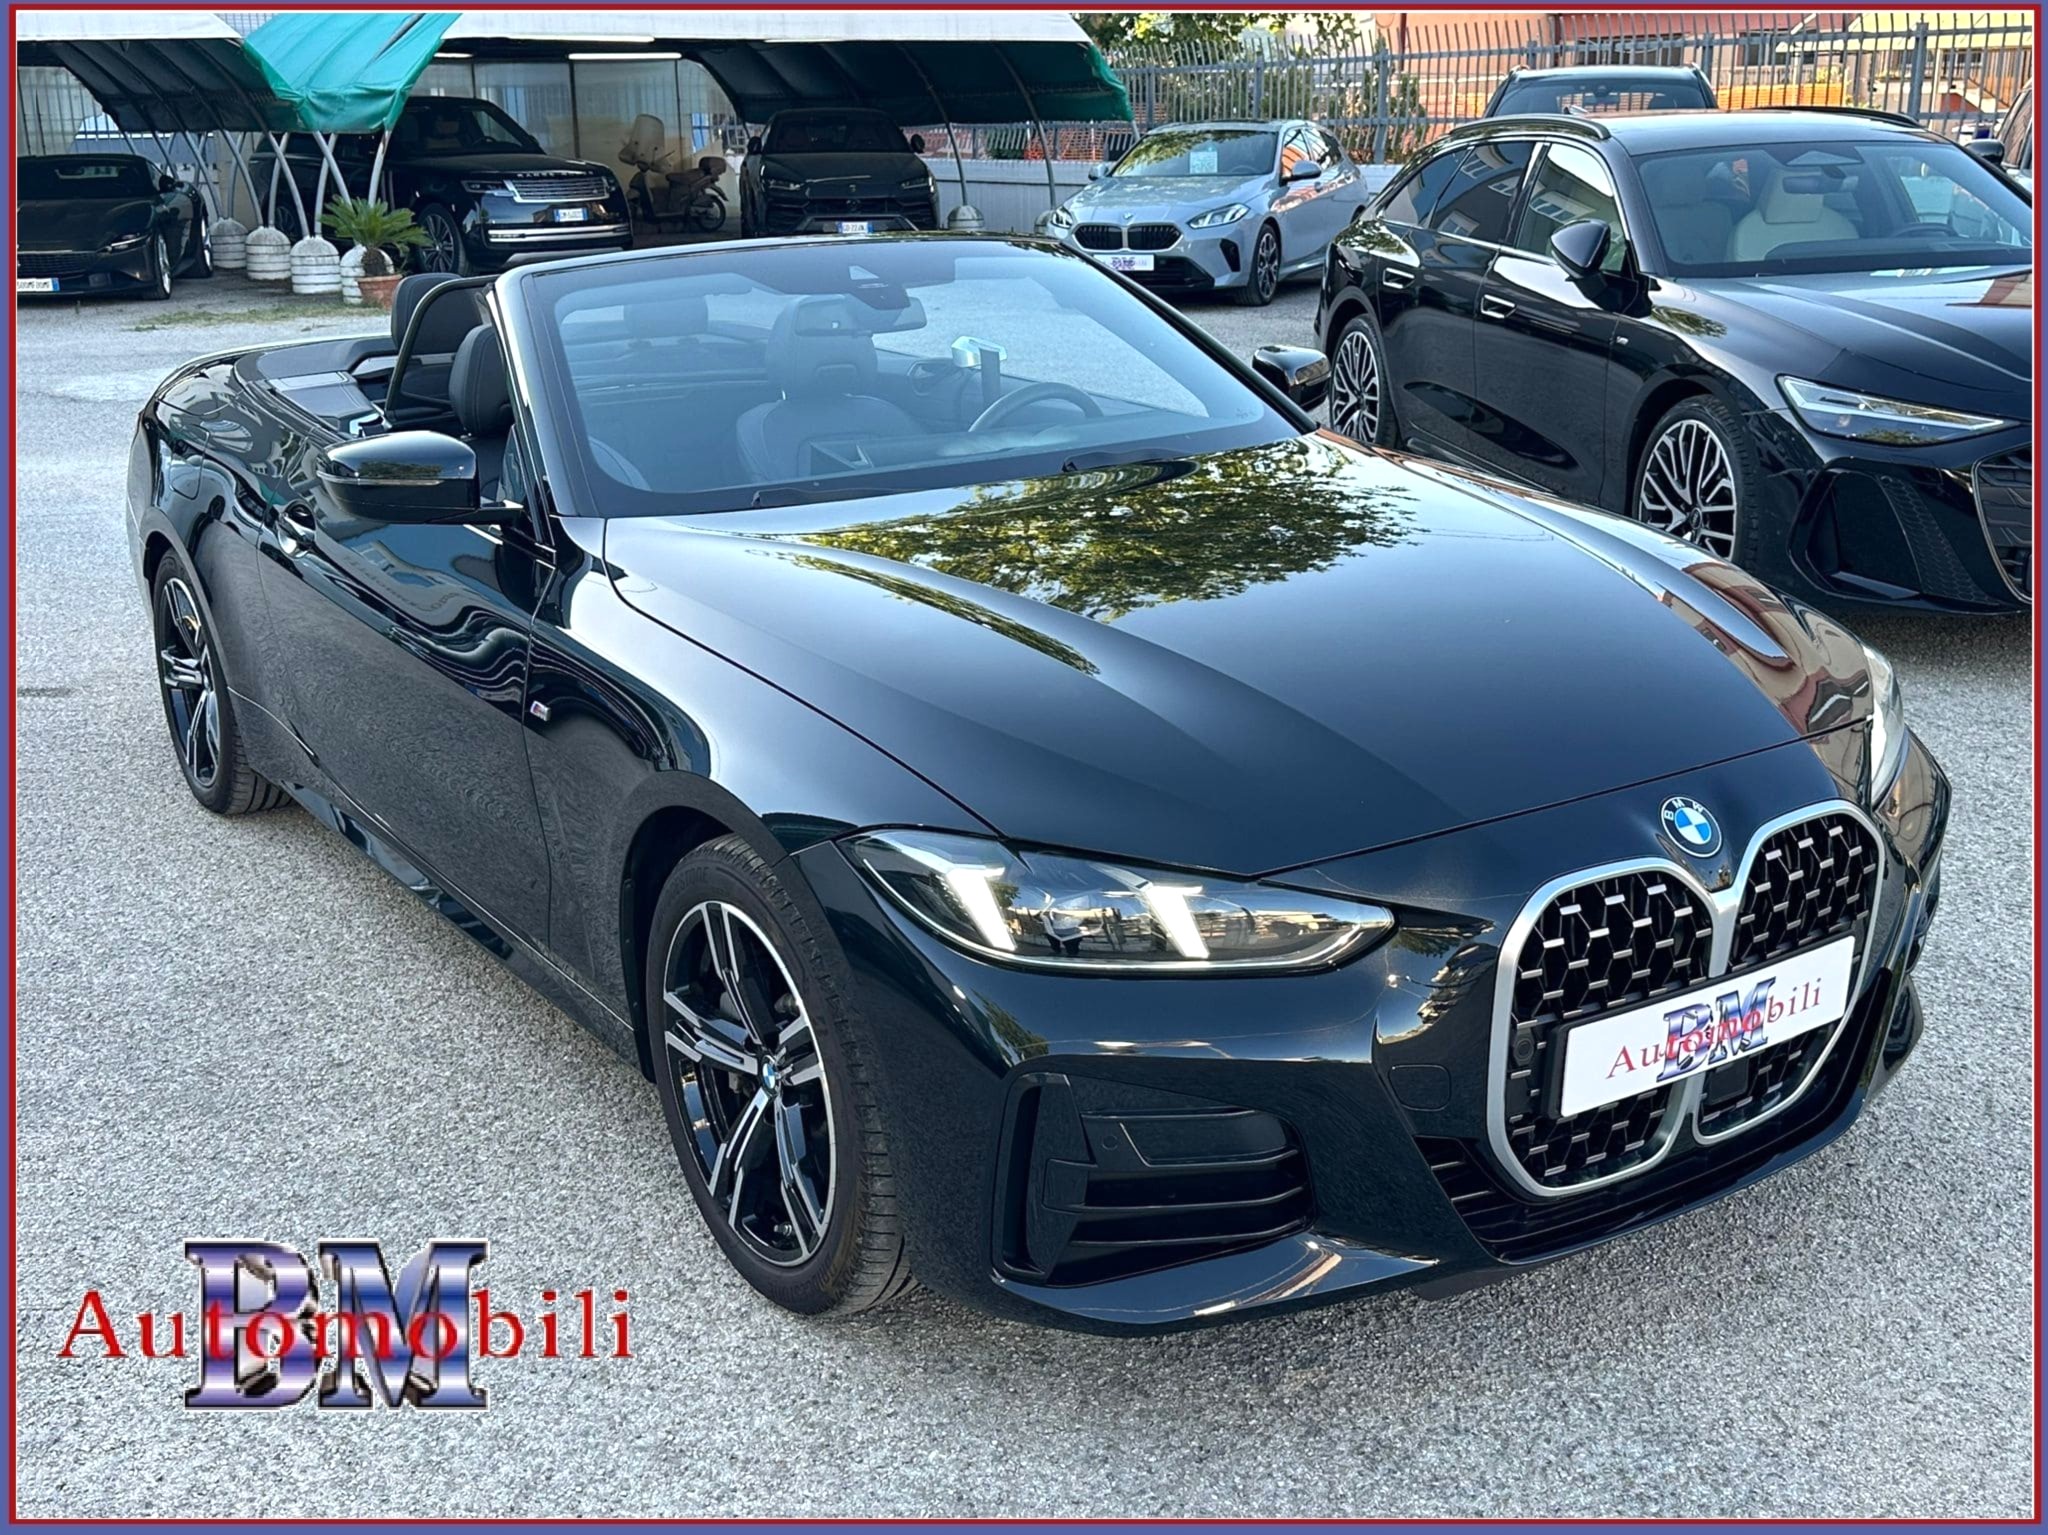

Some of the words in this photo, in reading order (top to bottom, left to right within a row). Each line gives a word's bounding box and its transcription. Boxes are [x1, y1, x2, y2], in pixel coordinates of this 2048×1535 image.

[1664, 797, 1704, 821] BMW
[1605, 977, 1822, 1079] Automobili
[1656, 976, 1776, 1082] BM
